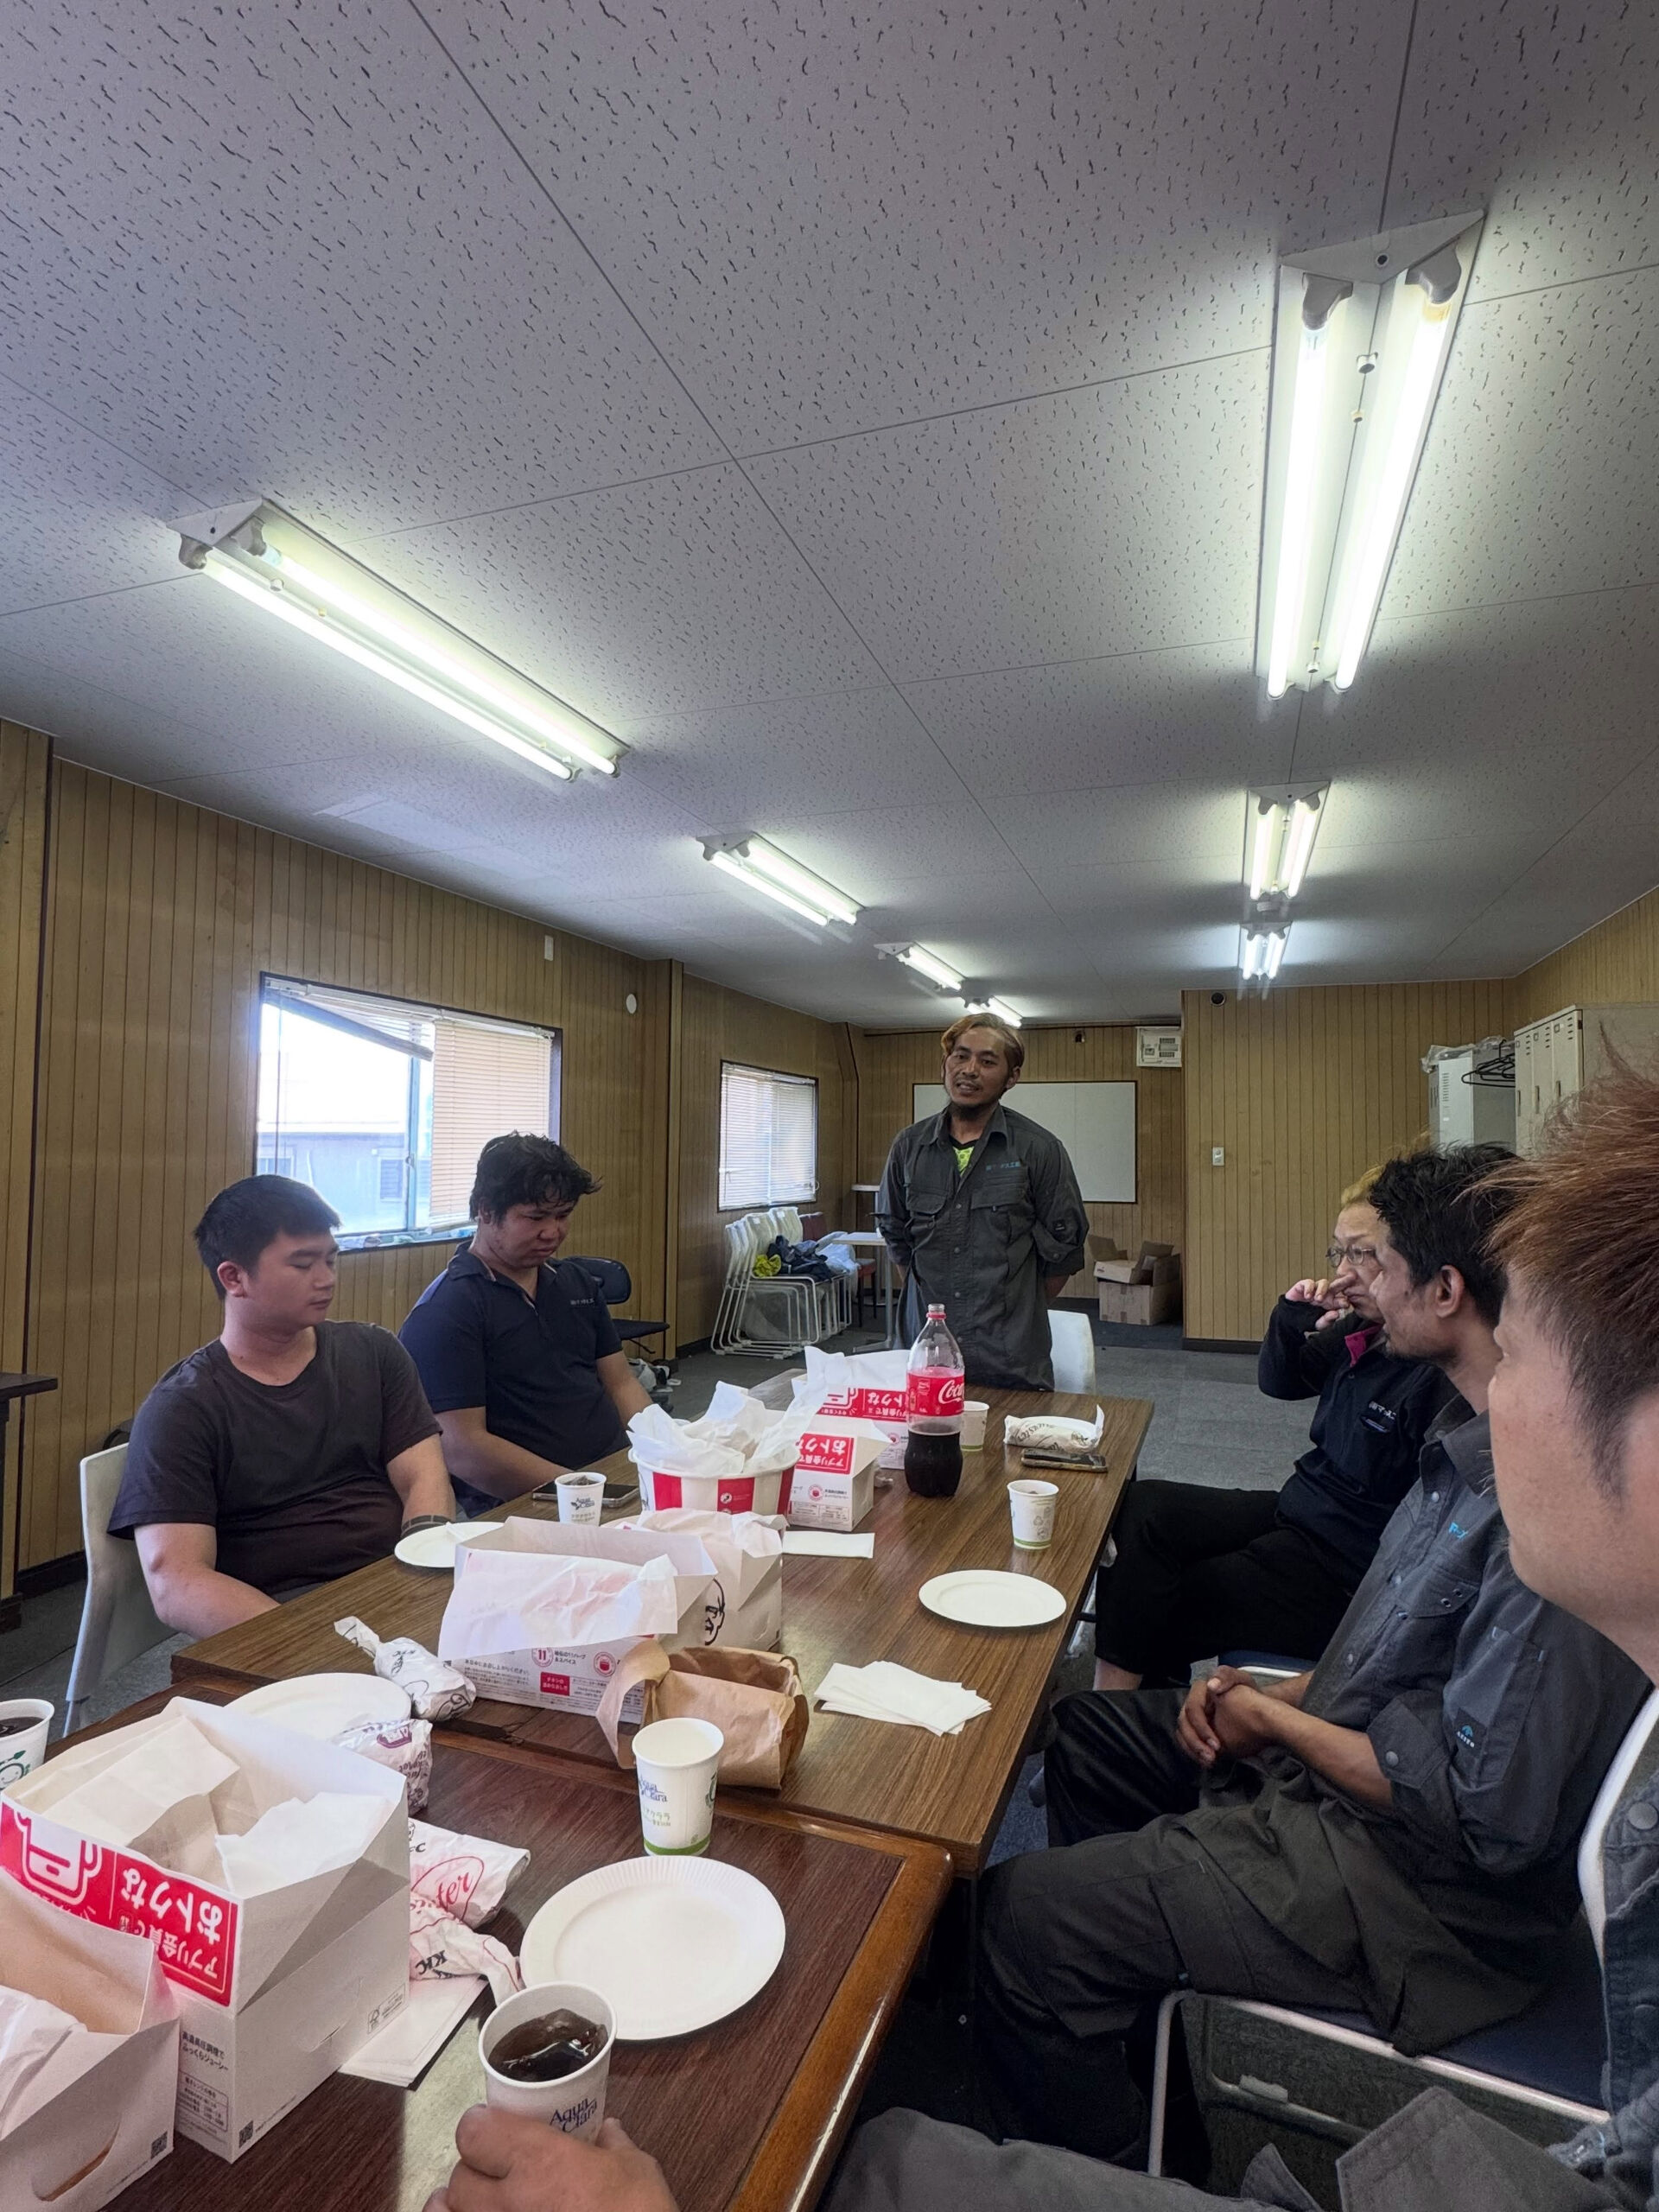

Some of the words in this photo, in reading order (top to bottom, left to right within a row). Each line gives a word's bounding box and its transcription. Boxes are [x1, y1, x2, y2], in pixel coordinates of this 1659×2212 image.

[868, 1392, 907, 1407] トクな
[875, 1407, 907, 1417] プリ会員で
[538, 1649, 547, 1661] 11
[121, 1868, 223, 1945] おトクな
[550, 2098, 596, 2126] Aqua
